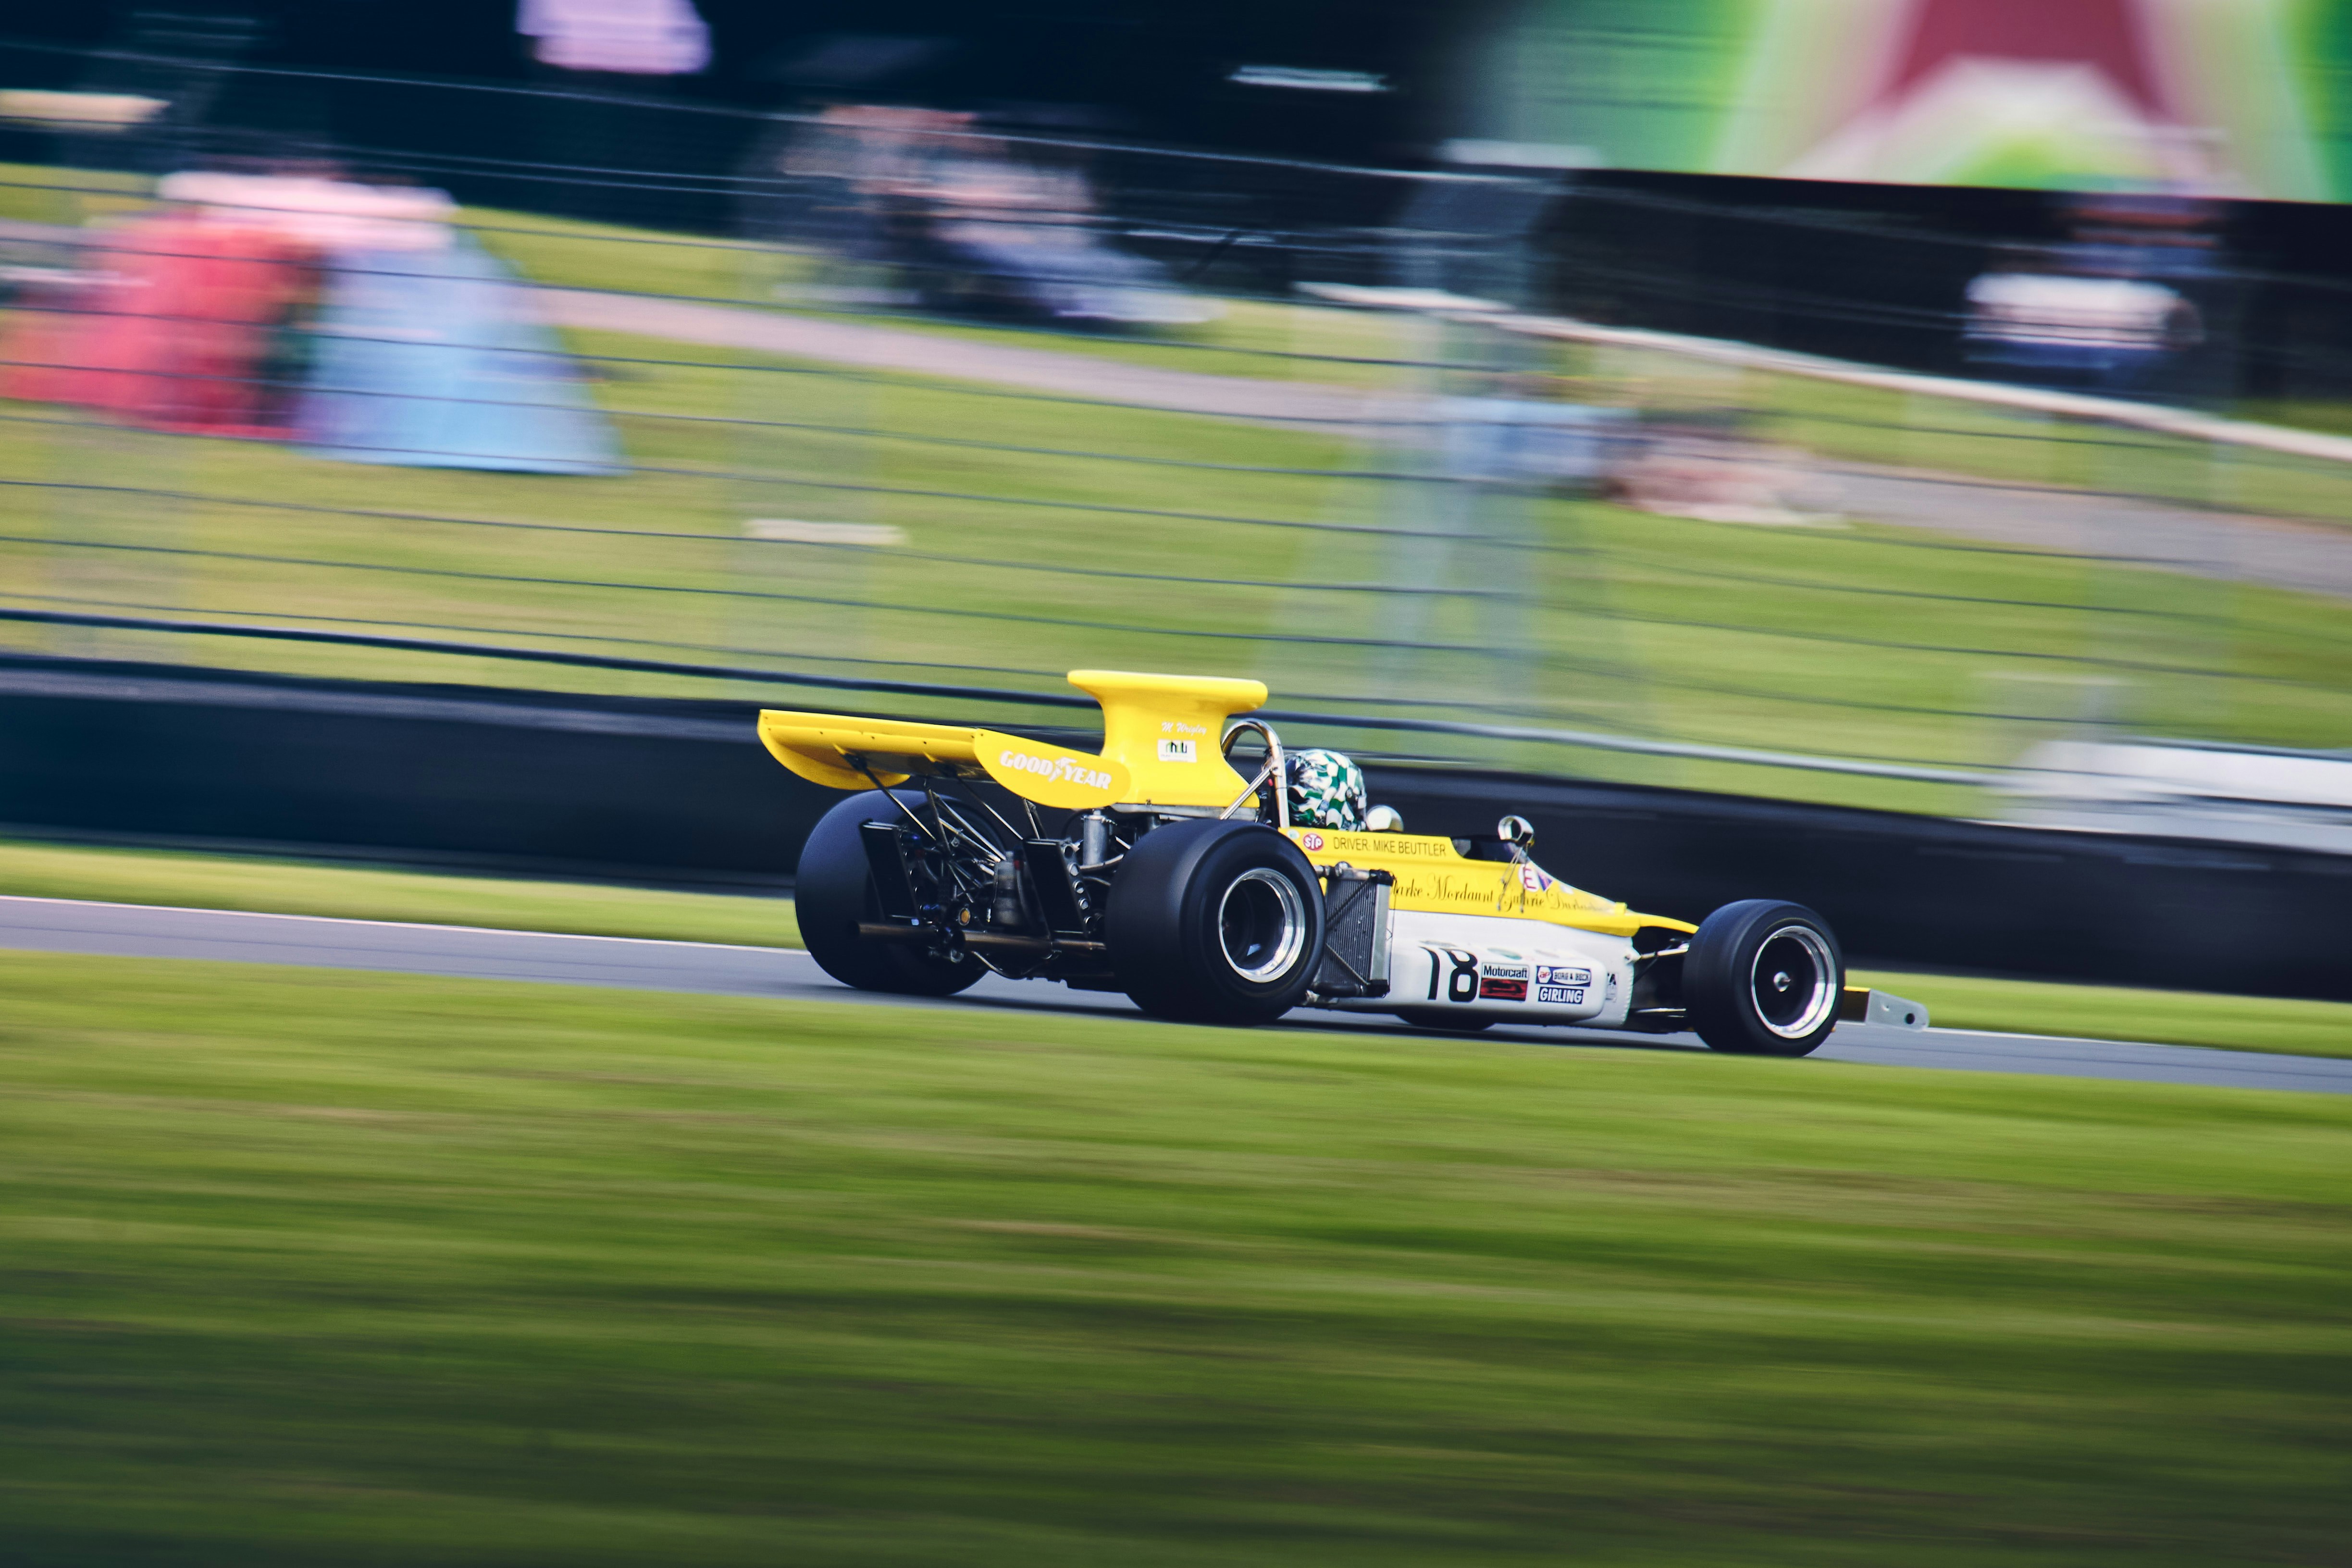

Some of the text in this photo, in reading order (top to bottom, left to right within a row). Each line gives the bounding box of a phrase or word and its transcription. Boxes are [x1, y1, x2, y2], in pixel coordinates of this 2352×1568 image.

[1176, 721, 1207, 737] Wrigley
[1304, 834, 1322, 850] STP
[1333, 837, 1446, 856] DRIVER: MIKE BEUTTLER
[1391, 878, 1423, 898] larke
[1427, 872, 1493, 903] Mordaunt
[1418, 946, 1479, 1002] 18
[1483, 964, 1528, 978] Motorcraft
[1539, 987, 1583, 1003] GIRLING
